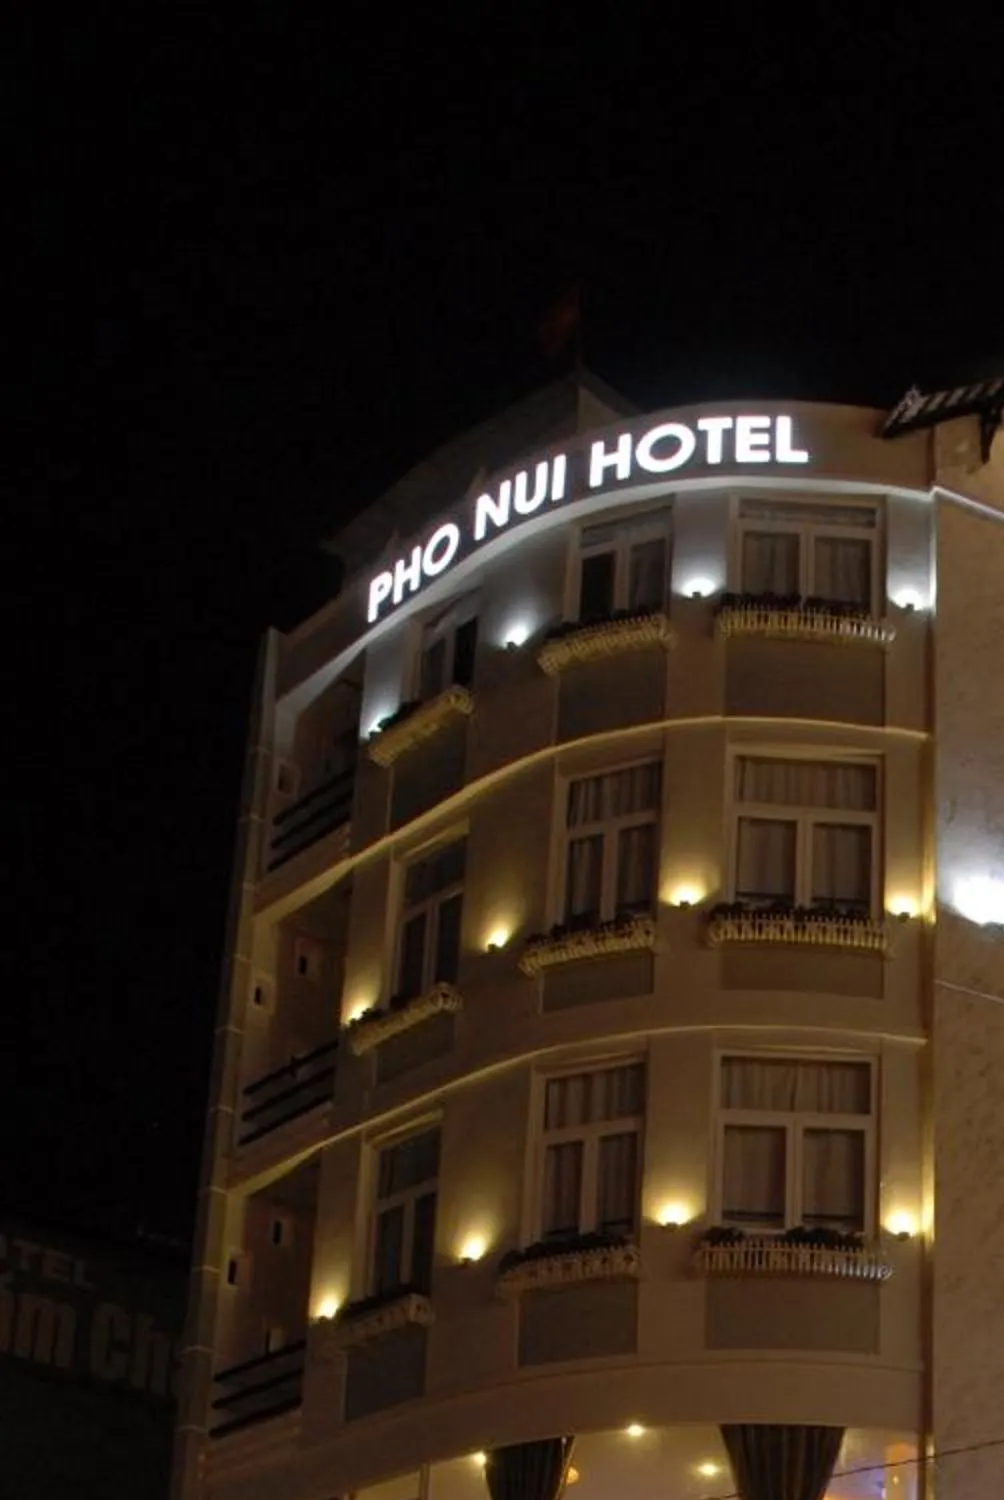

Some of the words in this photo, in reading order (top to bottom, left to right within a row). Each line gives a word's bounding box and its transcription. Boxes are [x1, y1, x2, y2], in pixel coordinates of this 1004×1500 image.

[366, 522, 460, 623] PHO
[473, 453, 567, 541] NUI
[588, 414, 809, 489] HOTEL
